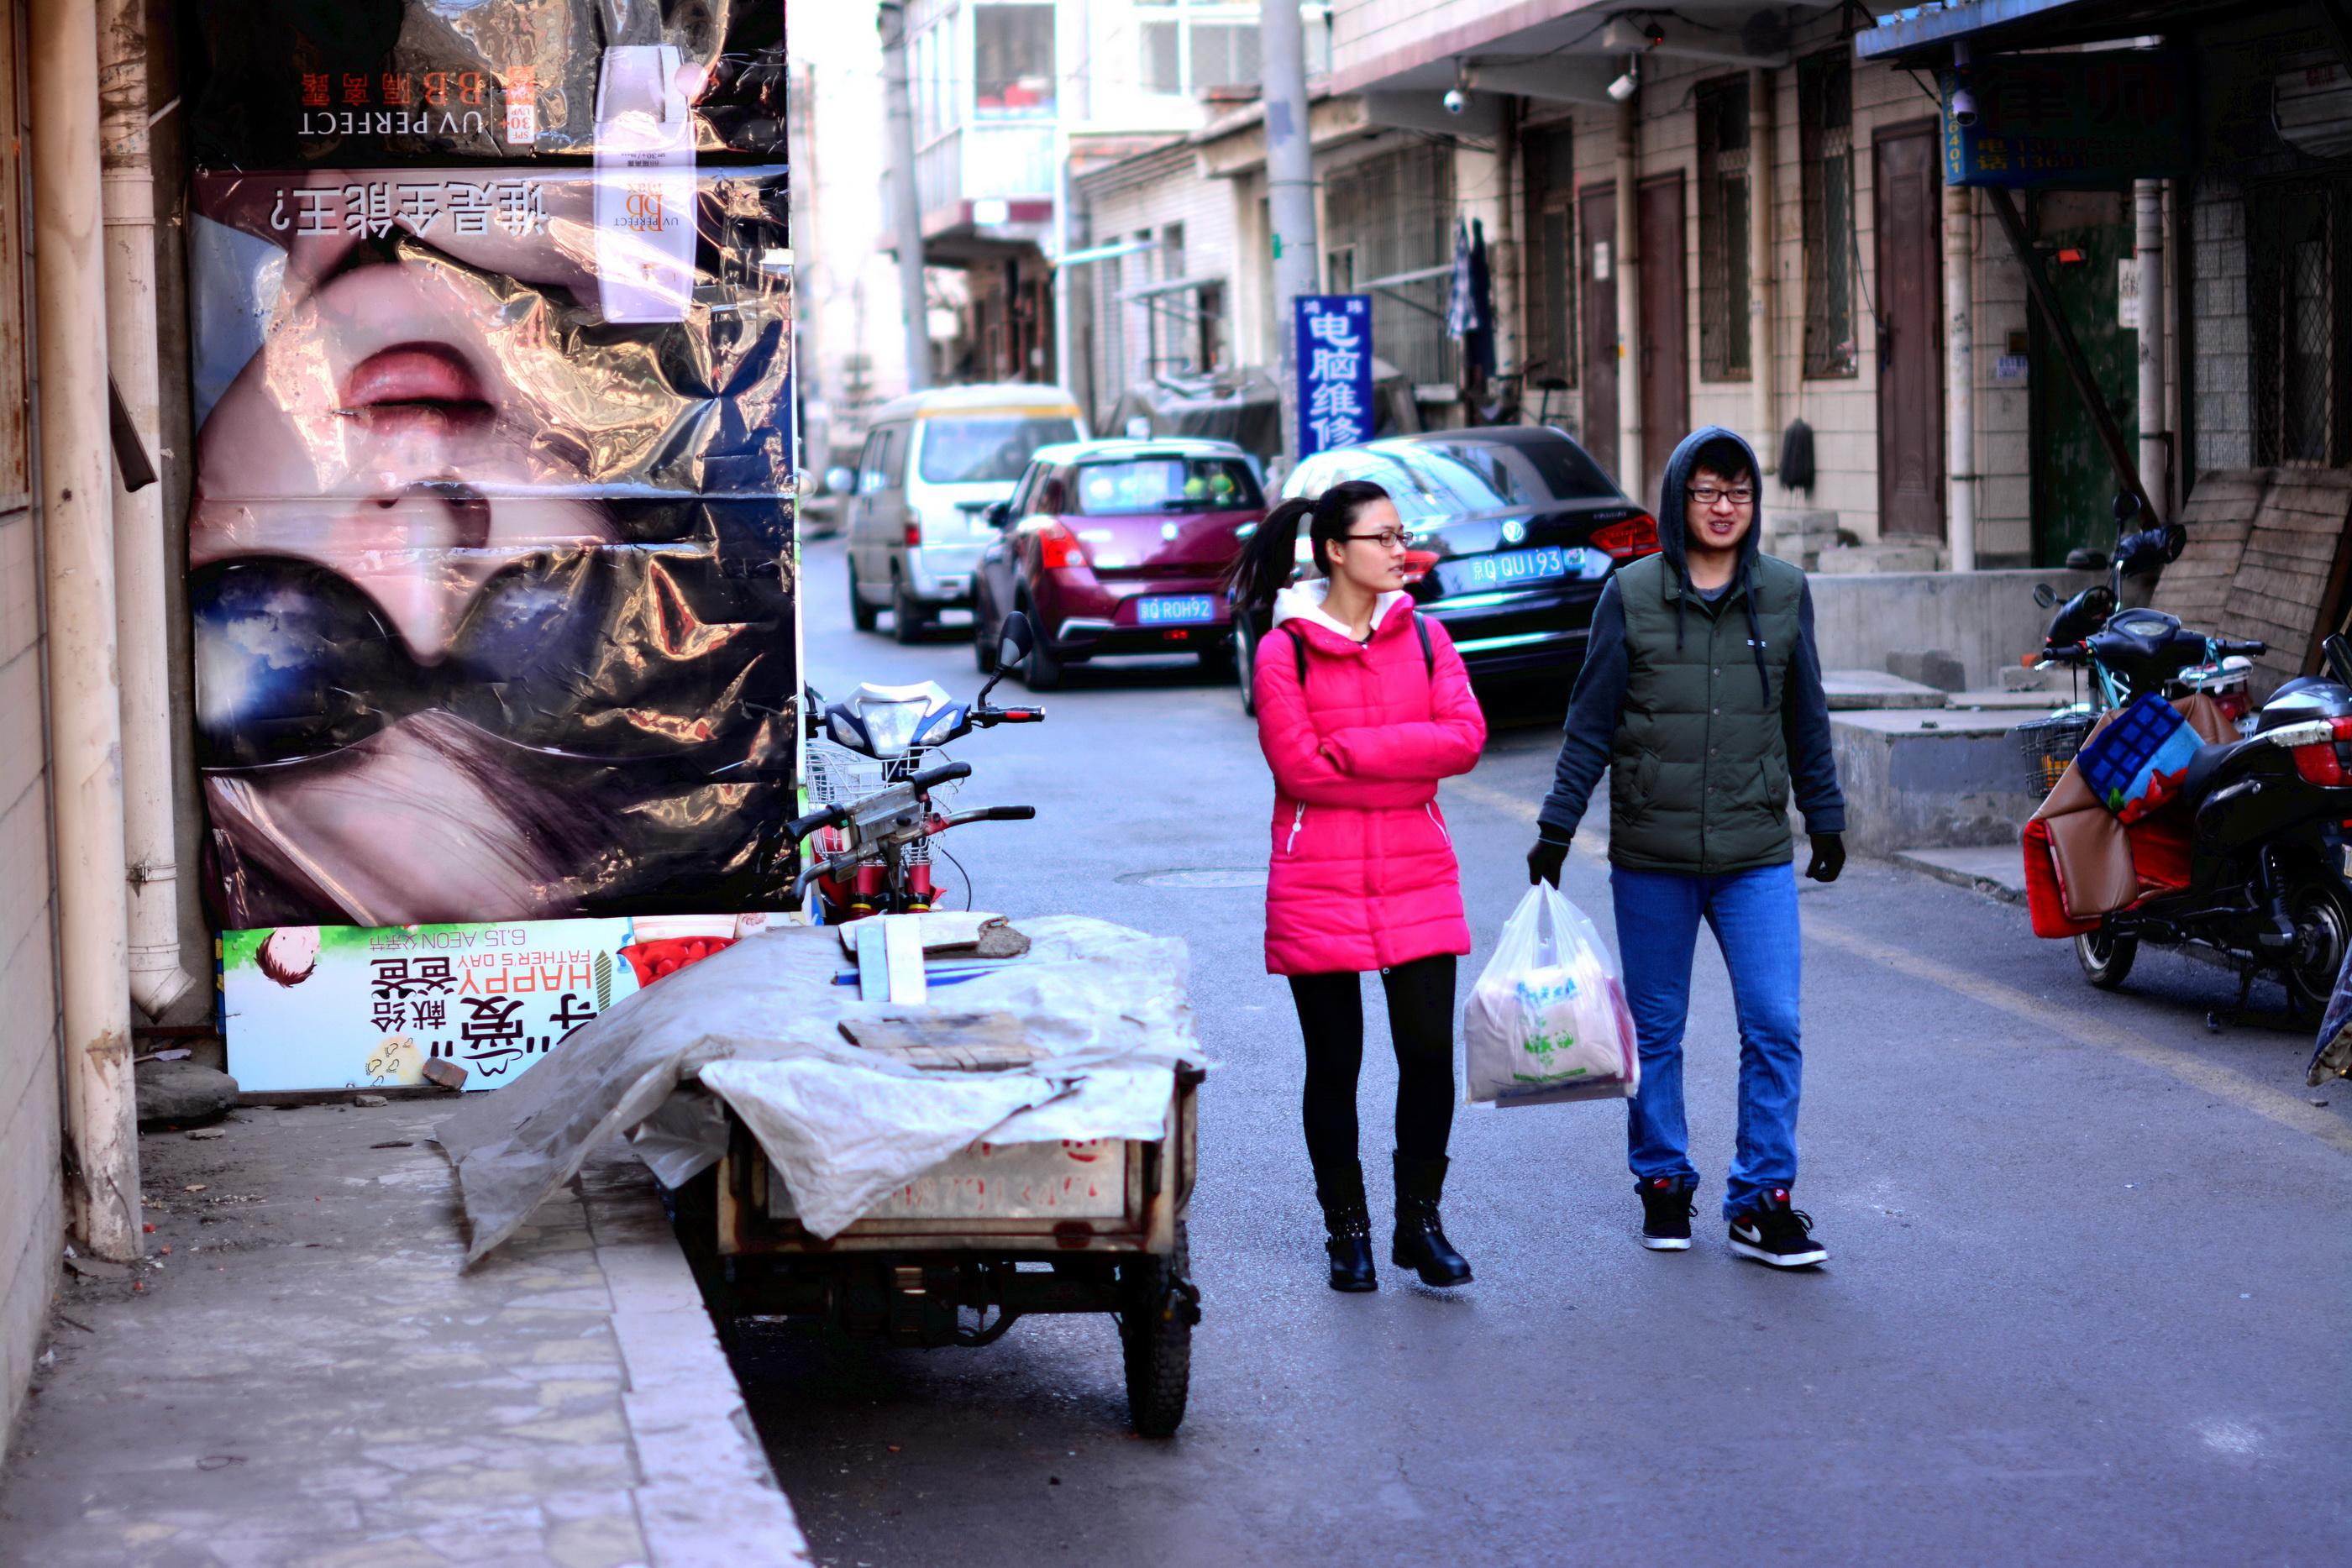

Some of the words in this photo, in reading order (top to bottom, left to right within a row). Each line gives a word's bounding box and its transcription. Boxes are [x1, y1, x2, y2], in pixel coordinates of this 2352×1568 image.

[301, 71, 483, 107] BB隔离露
[1982, 60, 2177, 132] 律师
[297, 111, 428, 134] PERFECT
[439, 111, 483, 134] UV
[500, 117, 531, 129] 30+
[512, 130, 529, 140] SPF
[270, 181, 548, 239] 谁是全能王?
[613, 218, 658, 227] PERFECT
[663, 218, 679, 226] UV
[1308, 312, 1362, 452] 电脑维修
[370, 934, 417, 952] 父亲节
[423, 931, 477, 948] AEON
[484, 929, 526, 947] 6.15
[458, 953, 495, 968] DAY
[501, 949, 591, 968] FATHER'S
[370, 956, 458, 999] 爸爸
[458, 963, 591, 995] HAPPY
[370, 1000, 447, 1033] 献给
